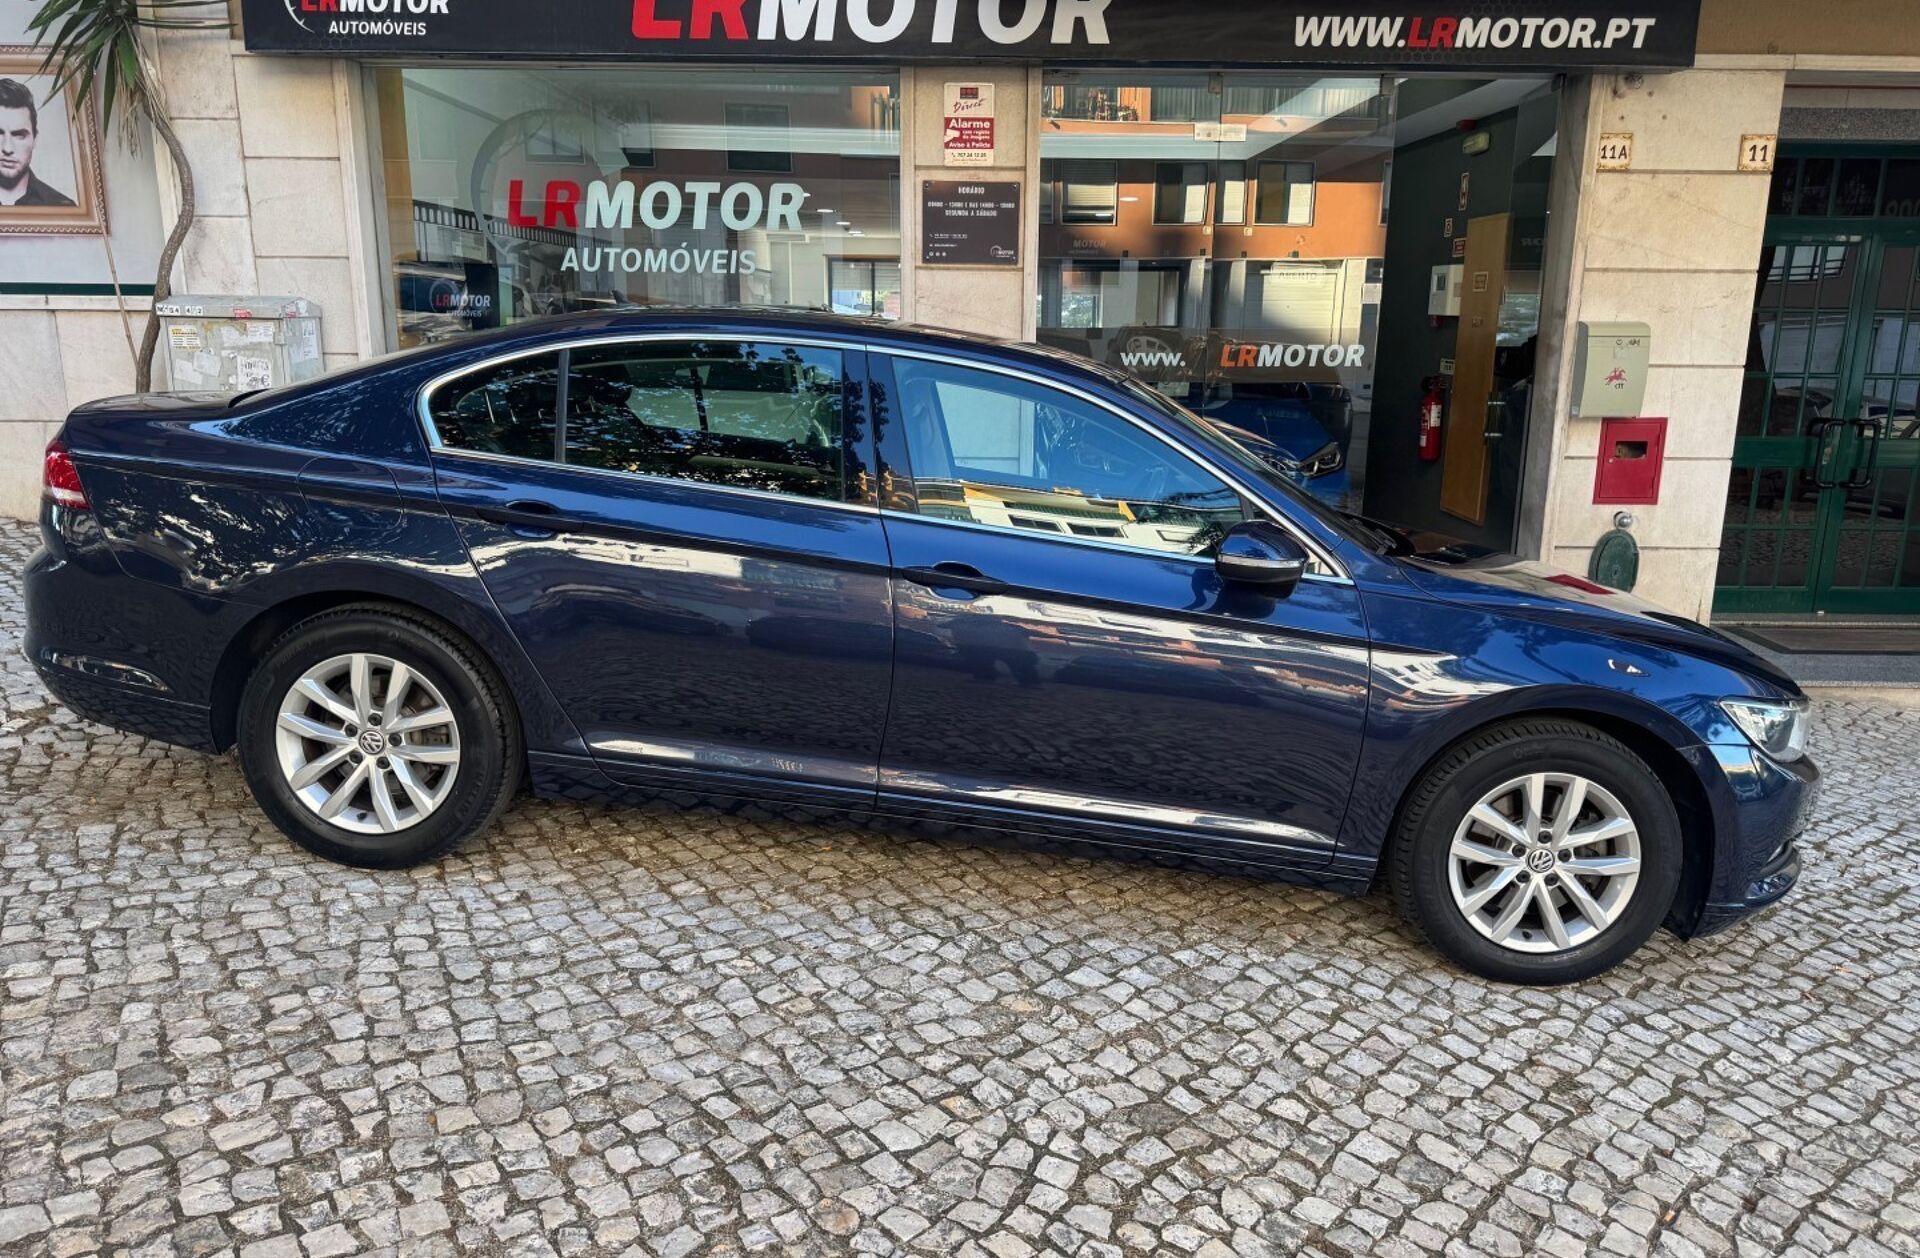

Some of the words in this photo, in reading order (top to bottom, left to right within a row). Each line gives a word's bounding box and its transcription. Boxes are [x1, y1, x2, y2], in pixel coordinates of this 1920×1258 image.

[328, 19, 427, 35] AUTOMÓVEIS
[632, 0, 1110, 44] LRMOTOR
[1295, 16, 1656, 48] WWW.LRMOTOR.PT
[949, 119, 990, 128] Alarme
[1600, 144, 1628, 160] 11A
[1749, 144, 1768, 162] 11
[507, 180, 805, 231] LRMOTOR
[560, 242, 756, 274] AUTOMÓVEIS
[1120, 352, 1186, 367] www.
[1220, 344, 1365, 367] LRMOTOR
